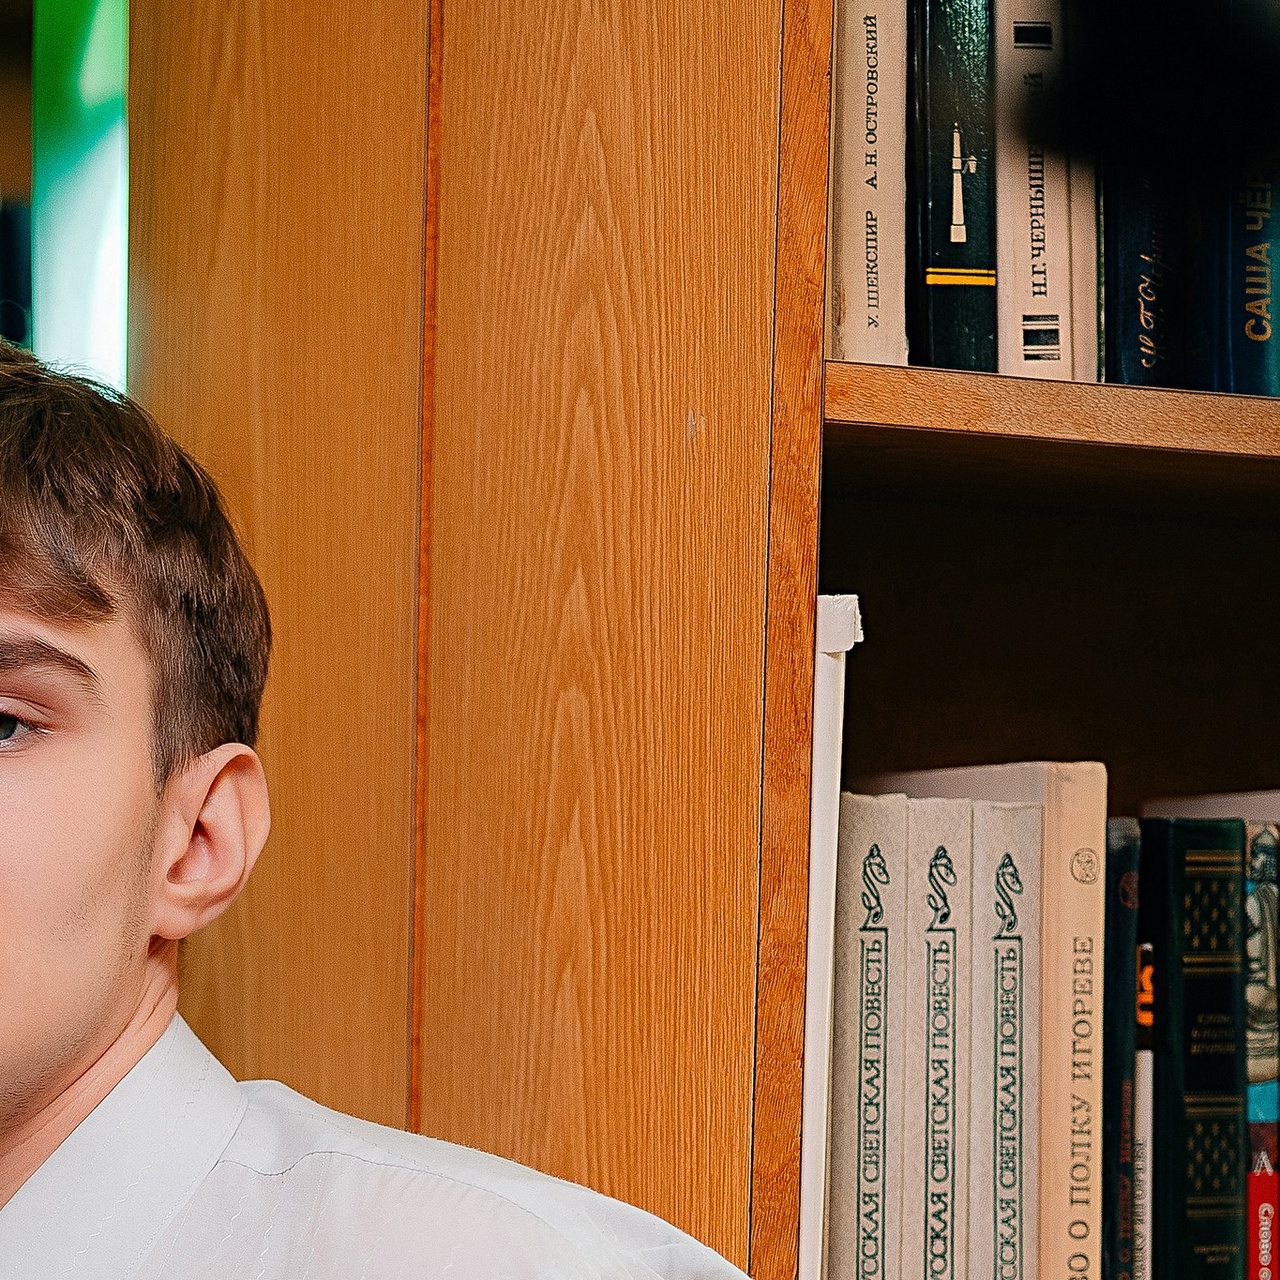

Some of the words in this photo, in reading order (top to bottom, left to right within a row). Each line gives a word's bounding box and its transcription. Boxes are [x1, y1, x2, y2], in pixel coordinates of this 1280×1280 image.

[862, 13, 879, 145] ОСТРОВСКИЙ
[864, 148, 878, 167] Н.
[864, 170, 879, 190] А.
[865, 209, 881, 309] ШЕКСПИР
[1244, 241, 1272, 341] САША
[868, 313, 881, 328] У.
[862, 940, 883, 1050] ПОВЕСТЬ
[930, 940, 951, 1050] ПОВЕСТЬ
[999, 948, 1019, 1058] ПОВЕСТЬ
[1069, 936, 1095, 1080] ИГОРЕВЕ
[861, 1059, 882, 1183] СВЕТСКАЯ
[929, 1059, 950, 1183] СВЕТСКАЯ
[998, 1067, 1018, 1191] СВЕТСКАЯ
[1069, 1092, 1092, 1207] ПОЛКУ
[1069, 1219, 1091, 1240] О
